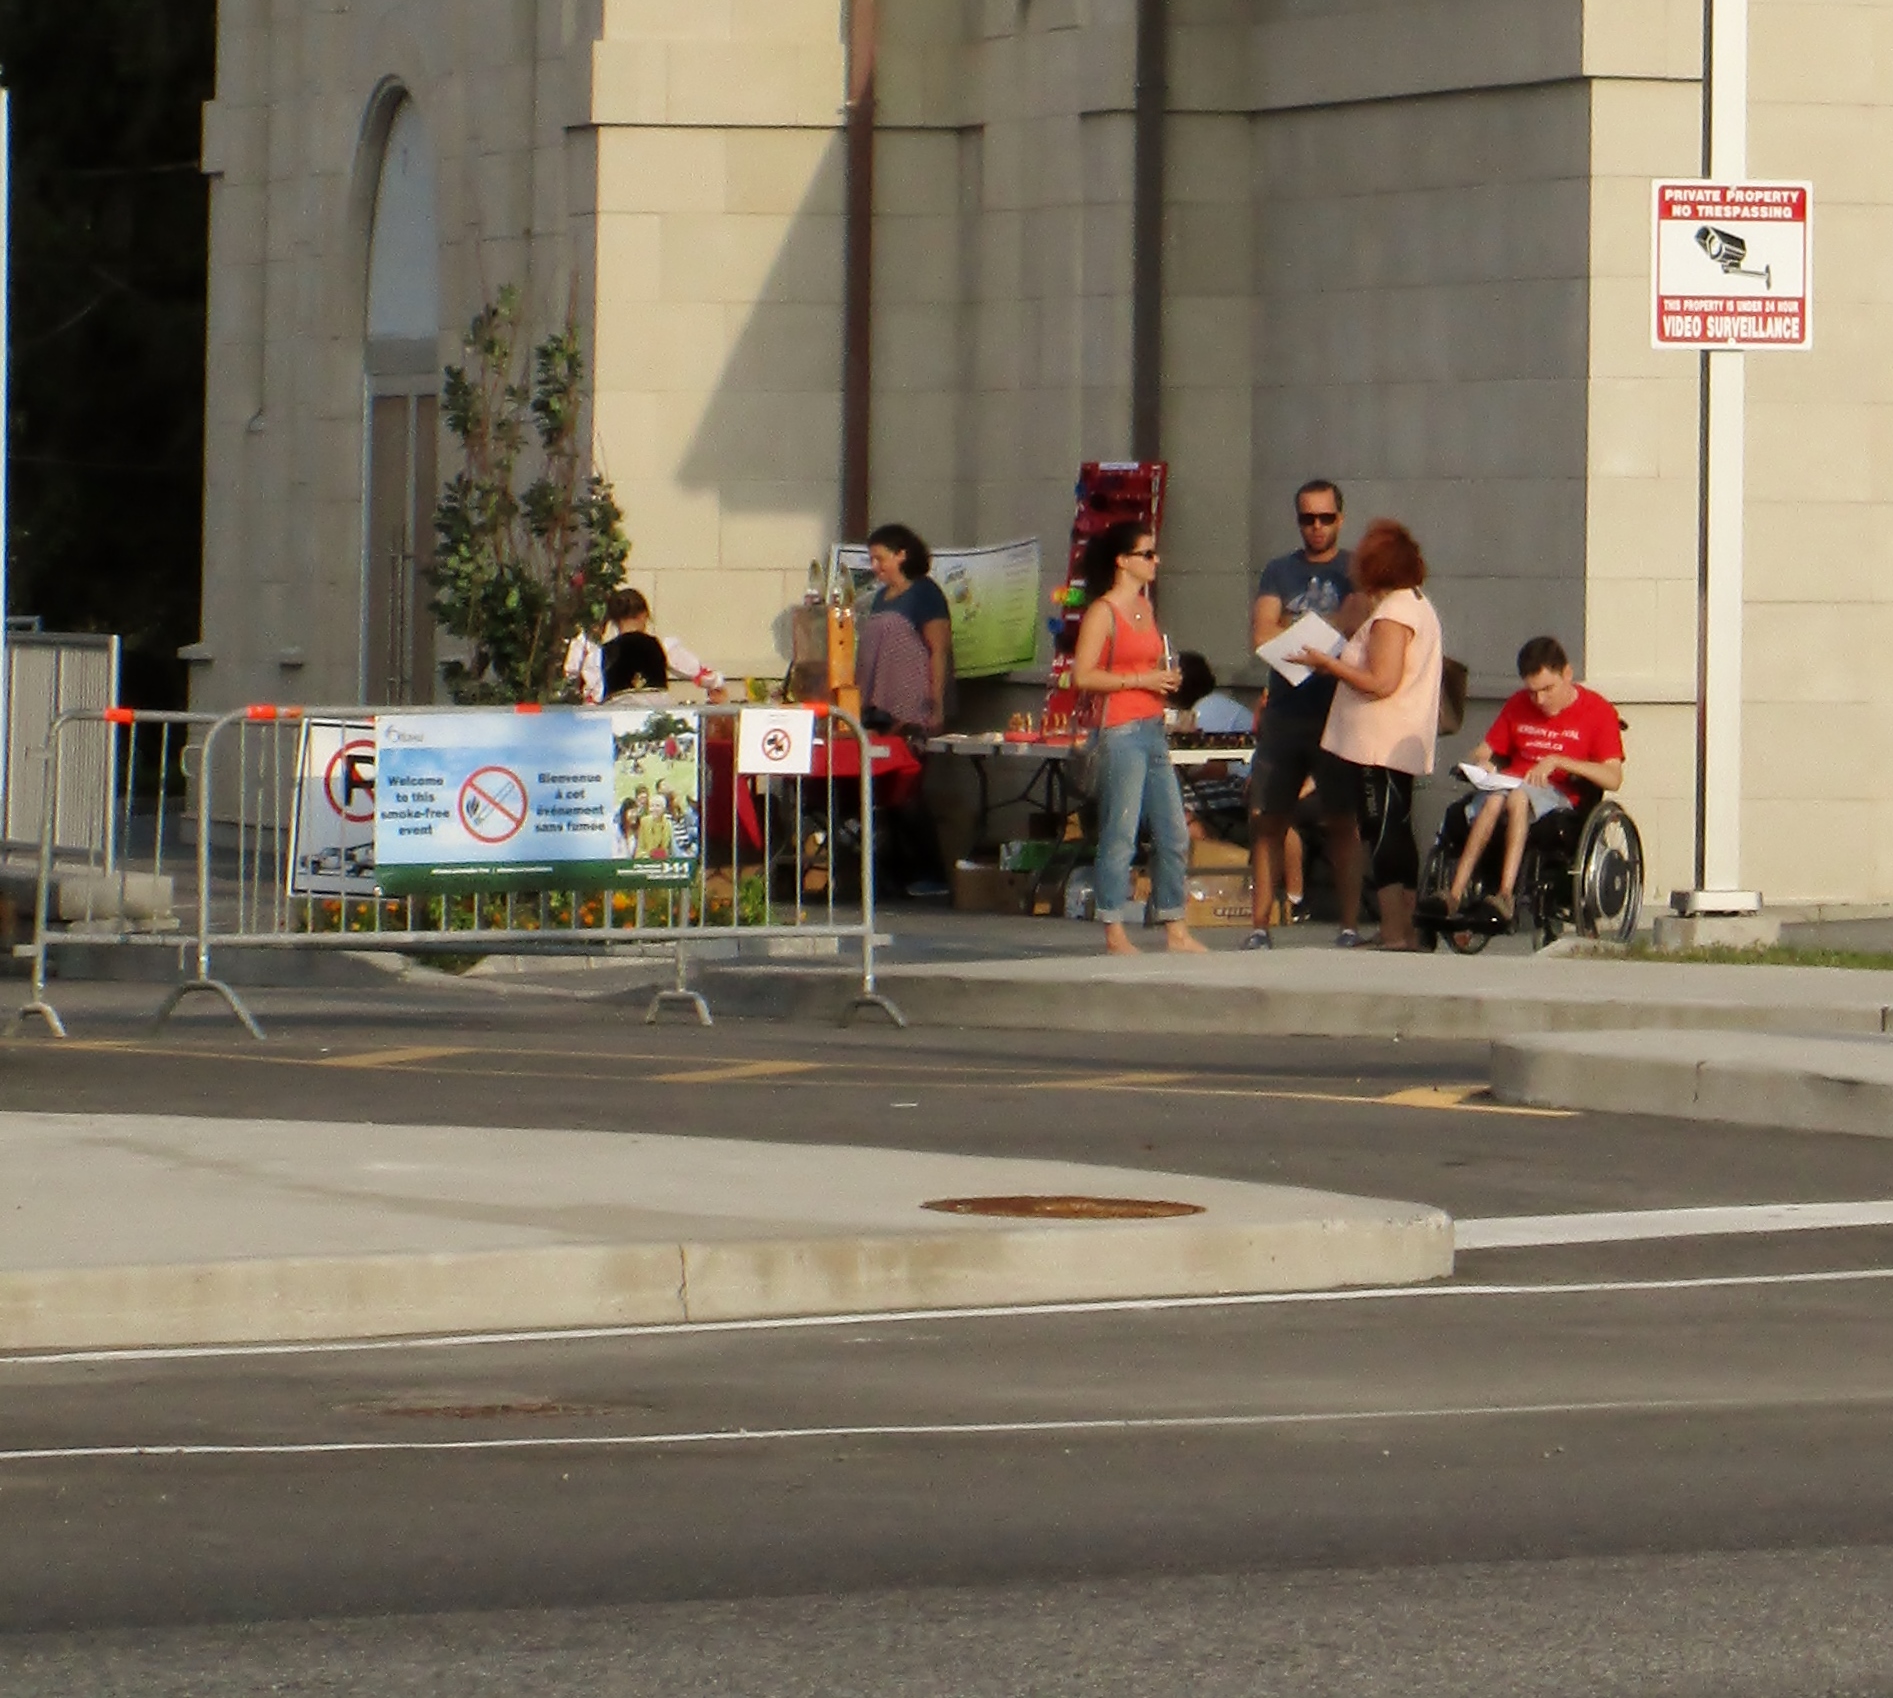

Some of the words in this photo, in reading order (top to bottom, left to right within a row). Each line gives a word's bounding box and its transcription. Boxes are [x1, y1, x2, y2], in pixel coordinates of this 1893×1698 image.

[1665, 189, 1721, 202] PRIVATE
[1726, 189, 1799, 203] PROPERTY
[1672, 204, 1692, 217] NO
[1697, 205, 1793, 218] TRESPASSING
[1683, 299, 1724, 312] PROPERTY
[1736, 300, 1763, 312] UNDER
[1663, 315, 1702, 338] VIDEO
[1706, 316, 1800, 339] SURVEILLANCE
[388, 775, 444, 786] Welcome
[538, 772, 602, 784] Bienvenue
[395, 792, 409, 803] to
[411, 791, 436, 803] this
[565, 788, 586, 800] cet
[380, 807, 450, 820] smoke-free
[398, 824, 433, 836] event
